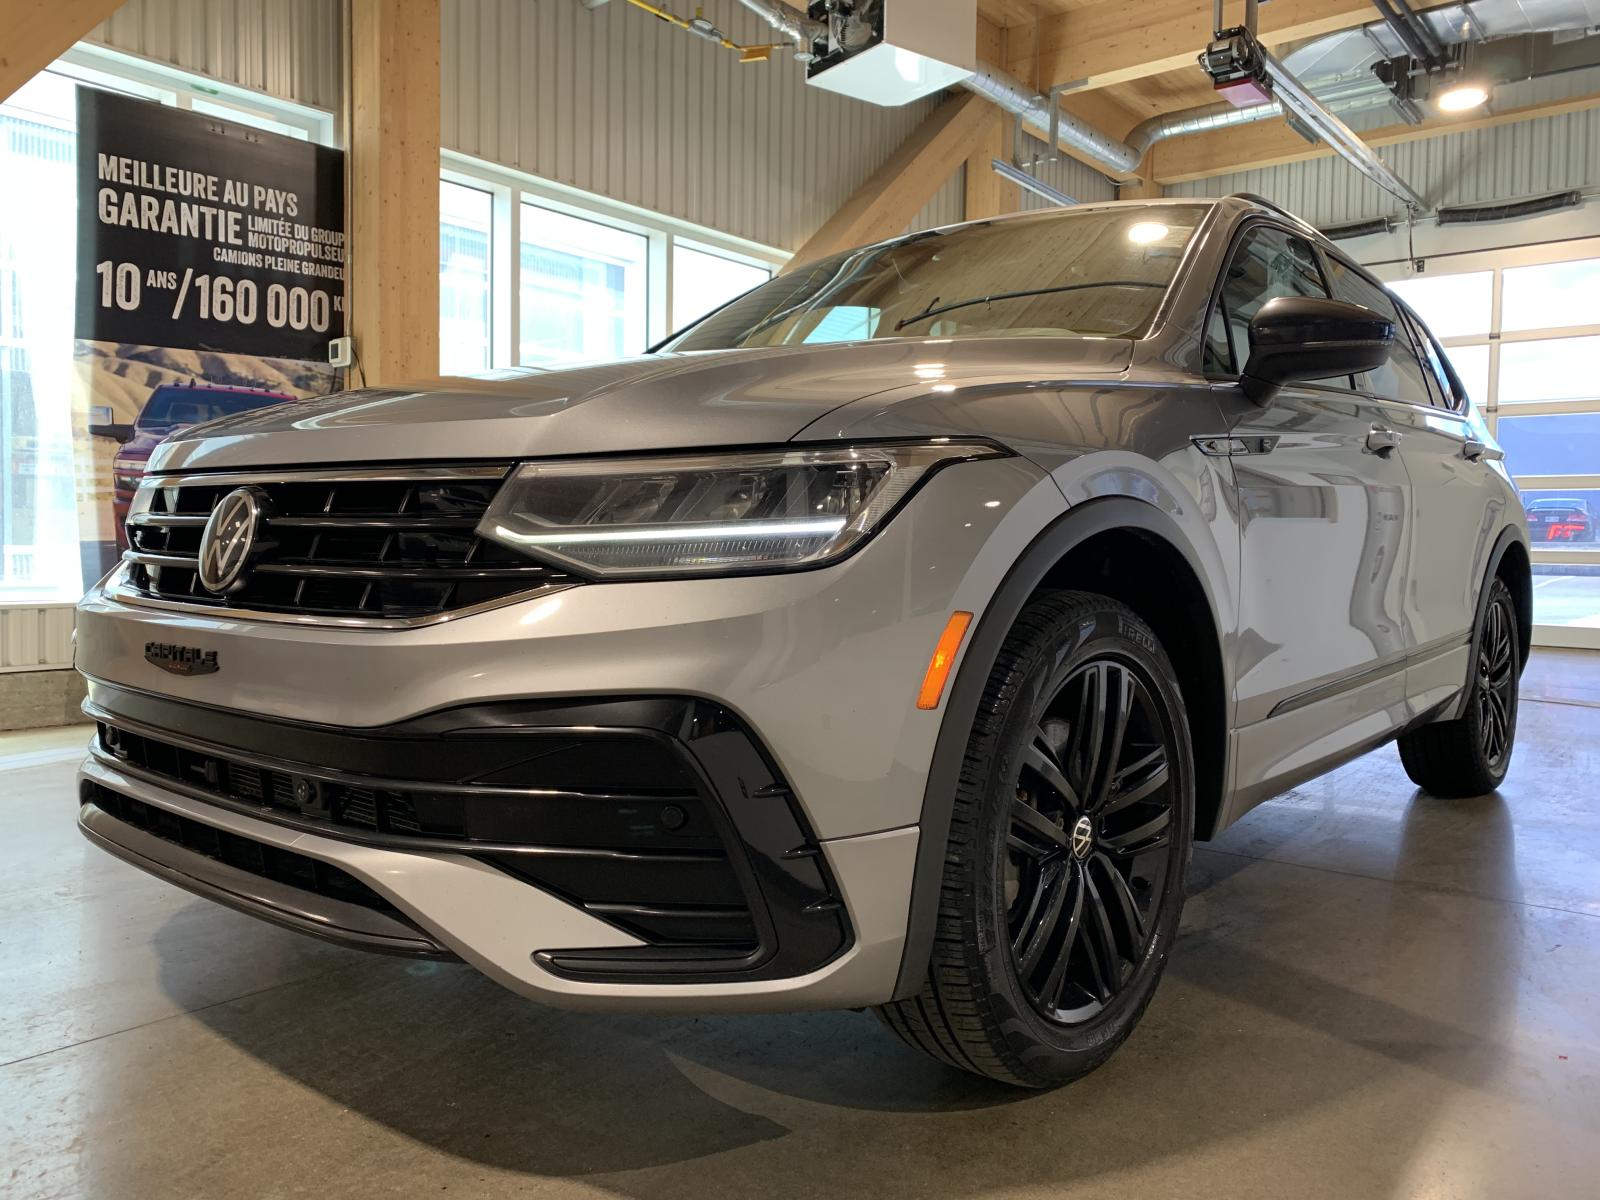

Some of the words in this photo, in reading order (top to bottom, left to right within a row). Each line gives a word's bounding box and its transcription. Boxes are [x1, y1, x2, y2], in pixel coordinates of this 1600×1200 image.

[98, 153, 219, 202] MEILLEURE
[223, 180, 249, 207] AU
[254, 186, 298, 217] PAYS
[98, 188, 242, 245] GARANTIE
[248, 216, 292, 238] LIMITÉE
[294, 222, 309, 241] DU
[213, 247, 263, 268] CAMIONS
[265, 255, 300, 274] PLEINE
[96, 260, 140, 311] 10
[267, 284, 330, 333] 000
